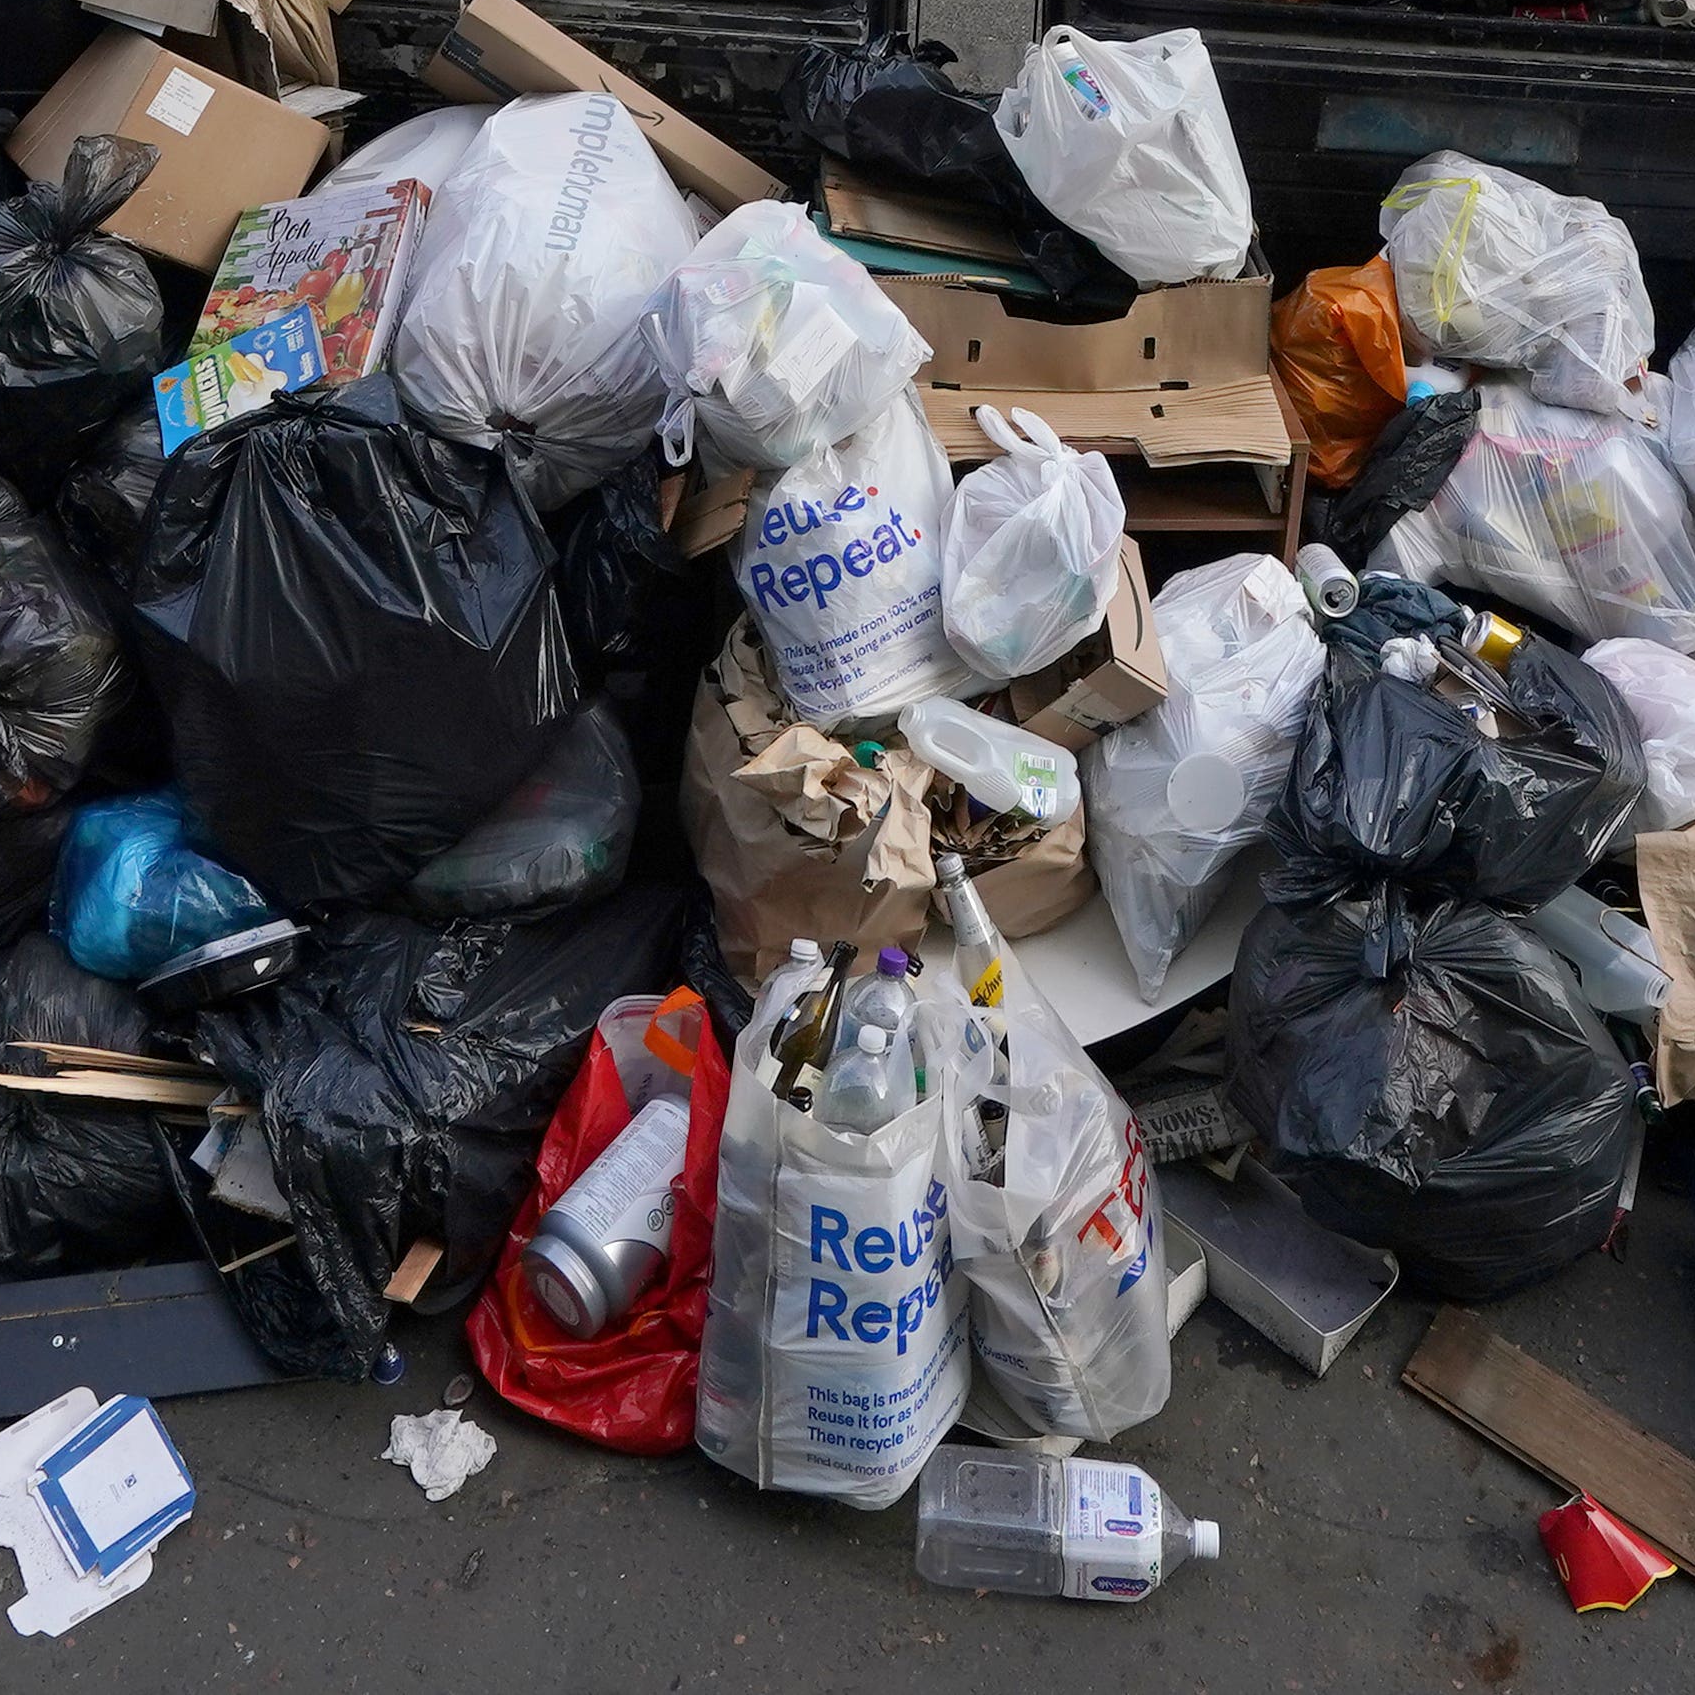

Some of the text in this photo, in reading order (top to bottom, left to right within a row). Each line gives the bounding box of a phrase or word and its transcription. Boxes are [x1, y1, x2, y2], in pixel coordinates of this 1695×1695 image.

[266, 207, 312, 243] Bon
[255, 239, 327, 284] Appetit
[750, 505, 922, 614] Repeat.
[825, 627, 860, 651] made
[854, 639, 879, 660] long
[1148, 1104, 1220, 1139] VOWS:
[810, 1172, 949, 1274] Reuse
[807, 1385, 839, 1404] This
[842, 1387, 870, 1411] bag
[873, 1392, 885, 1408] is
[889, 1376, 923, 1406] made
[808, 1406, 855, 1428] Reuse
[858, 1412, 870, 1430] it
[872, 1411, 895, 1431] for
[897, 1408, 912, 1424] as
[808, 1423, 918, 1454] Then recycle it.
[807, 1453, 899, 1477] Find out more at
